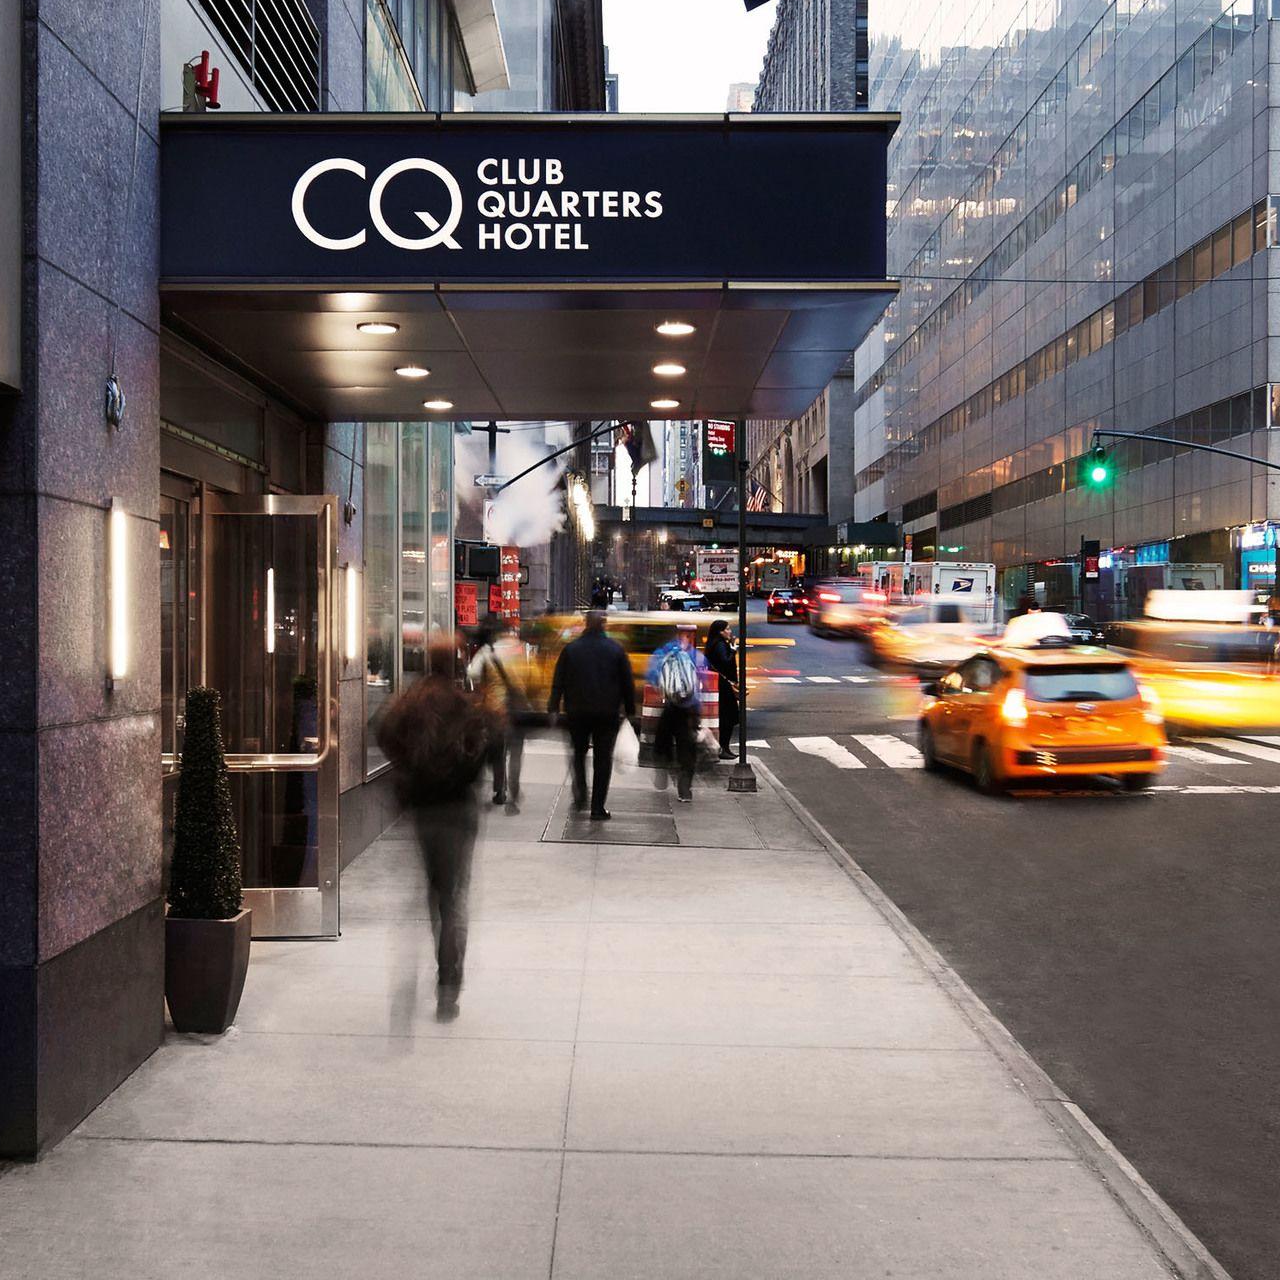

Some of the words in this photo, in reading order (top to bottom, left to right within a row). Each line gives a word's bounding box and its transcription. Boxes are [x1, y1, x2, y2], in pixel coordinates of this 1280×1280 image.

[477, 158, 564, 185] CLUB
[291, 157, 463, 250] CQ
[477, 190, 663, 218] QUARTERS
[478, 222, 589, 250] HOTEL
